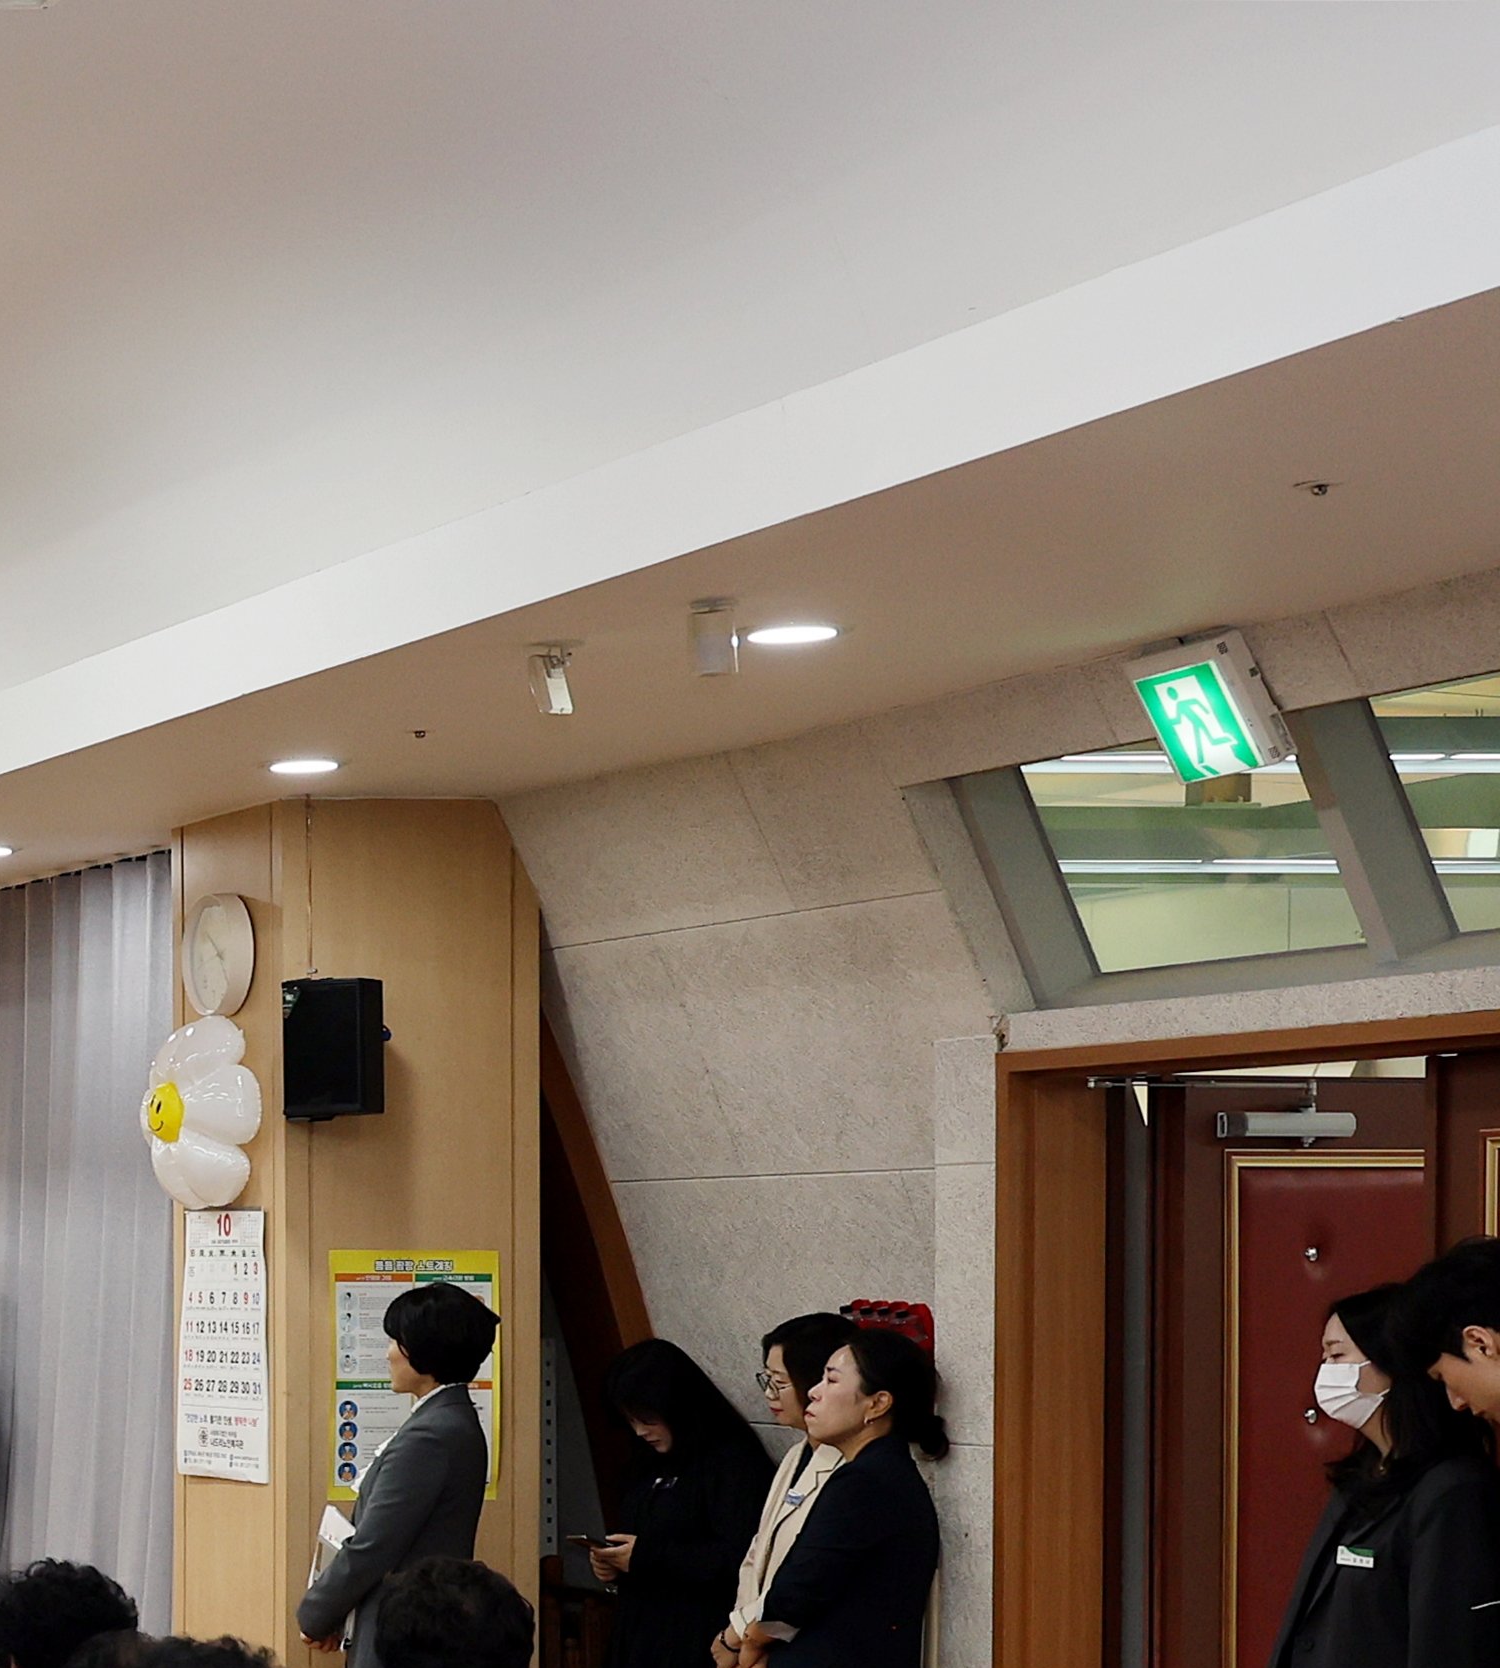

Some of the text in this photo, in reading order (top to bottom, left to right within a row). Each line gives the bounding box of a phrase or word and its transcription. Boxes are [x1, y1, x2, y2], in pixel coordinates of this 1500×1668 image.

[217, 1213, 232, 1237] 10
[234, 1262, 258, 1275] 1 2 3
[198, 1292, 203, 1305] 5
[209, 1292, 214, 1305] 6
[221, 1292, 226, 1305] 7
[233, 1292, 238, 1305] 8
[243, 1292, 249, 1305] 9
[185, 1321, 260, 1333] 11 12 13 14 15 16 17
[185, 1350, 260, 1363] 18 19 20 21 22 23 24
[184, 1378, 261, 1394] 25 26 27 28 29 30 31
